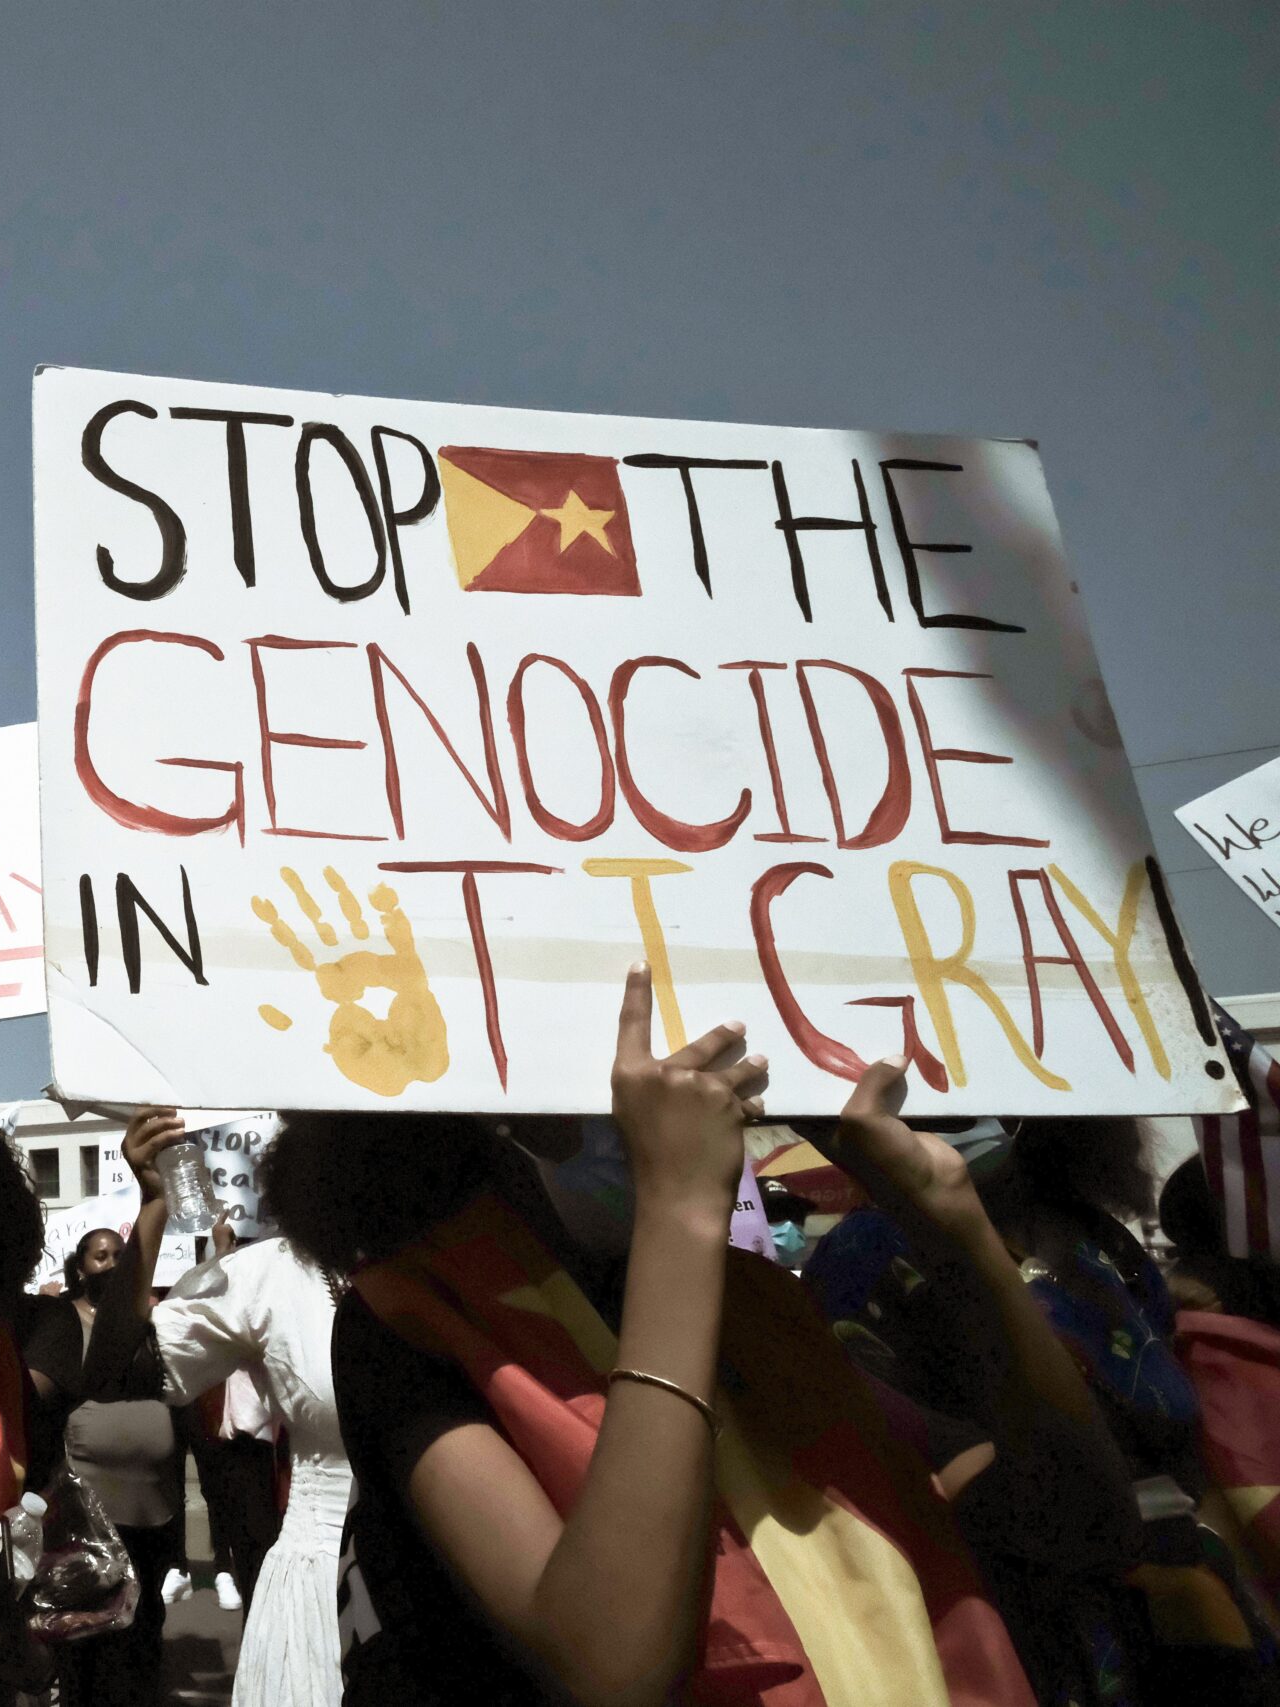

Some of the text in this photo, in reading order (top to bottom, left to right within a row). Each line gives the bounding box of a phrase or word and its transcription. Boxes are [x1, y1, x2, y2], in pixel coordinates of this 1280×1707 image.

[80, 399, 1027, 633] STOP THE
[73, 629, 1051, 852] GENOCIDE
[1194, 813, 1280, 860] We
[78, 864, 210, 995] IN
[734, 1199, 756, 1212] en
